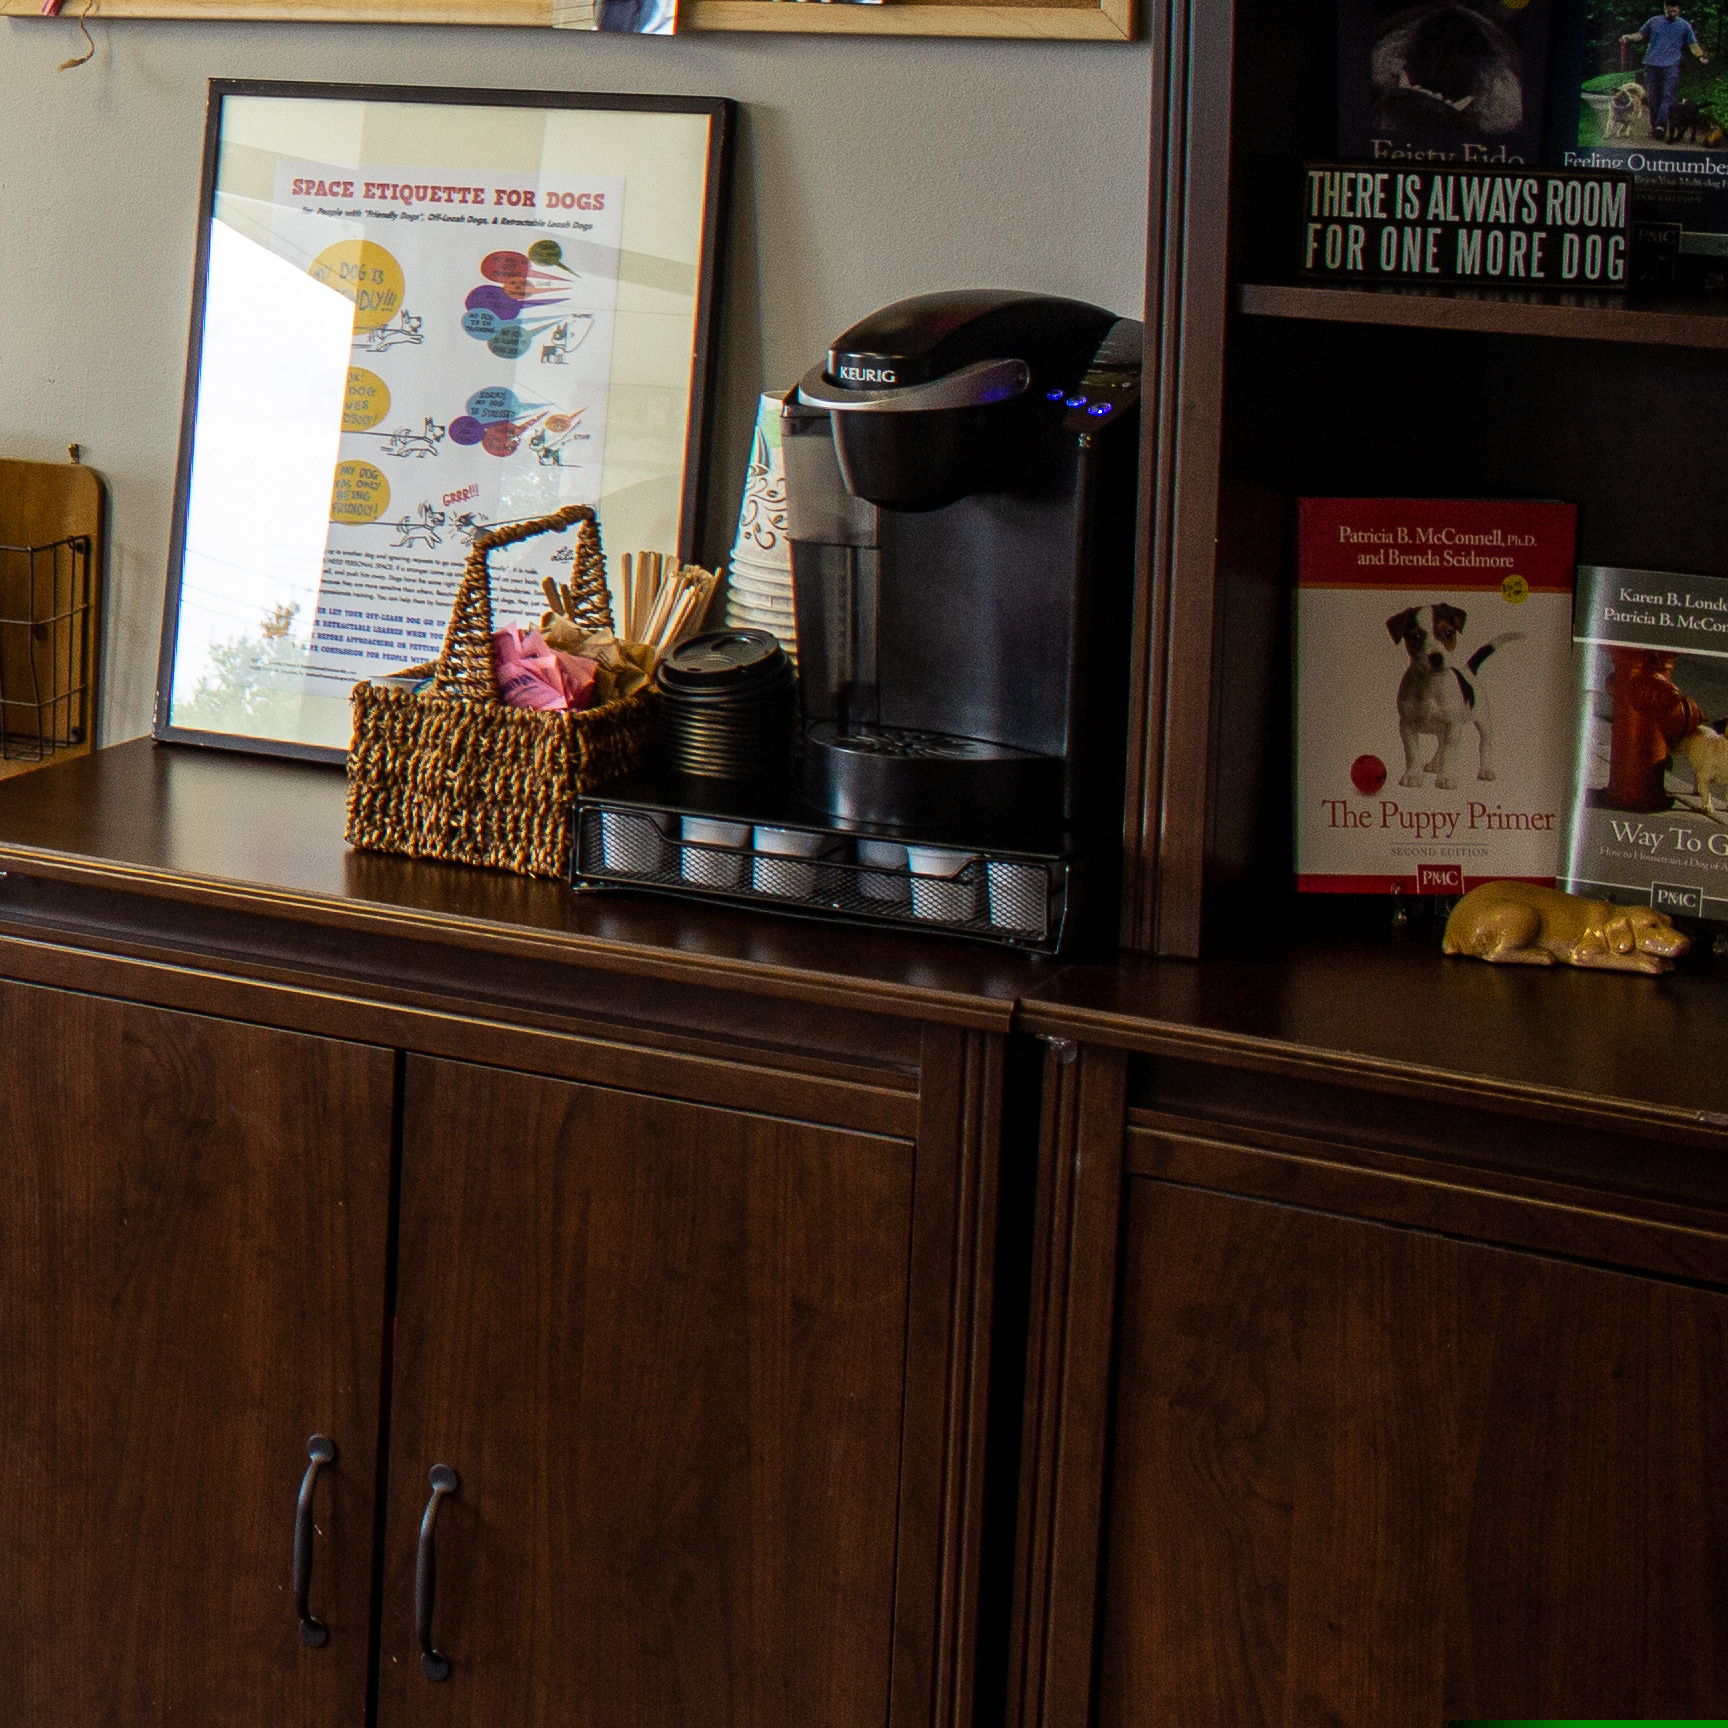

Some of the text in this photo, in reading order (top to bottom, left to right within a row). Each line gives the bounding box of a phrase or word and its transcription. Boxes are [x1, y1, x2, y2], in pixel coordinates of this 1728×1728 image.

[1564, 151, 1623, 170] Feeling
[292, 178, 606, 212] SPACE ETIQUETTE FOR DOGS
[1308, 171, 1628, 229] THERE IS ALWAYS ROOM
[1305, 222, 1626, 281] FOR ONE MORE DOG
[840, 365, 897, 383] KEURIG
[1338, 525, 1538, 549] Patricia B. McConnell, Ph.D.
[1357, 550, 1515, 569] and Brenda Scidmore
[1618, 587, 1661, 605] Karen
[1662, 592, 1682, 607] B.
[1603, 608, 1656, 627] Patricia
[1659, 612, 1675, 627] B.
[1324, 799, 1556, 839] The Puppy Primer
[1609, 820, 1702, 854] Way To
[1390, 847, 1489, 859] SECOND EDITION
[1422, 868, 1460, 887] PMC
[1657, 889, 1697, 908] PMC
